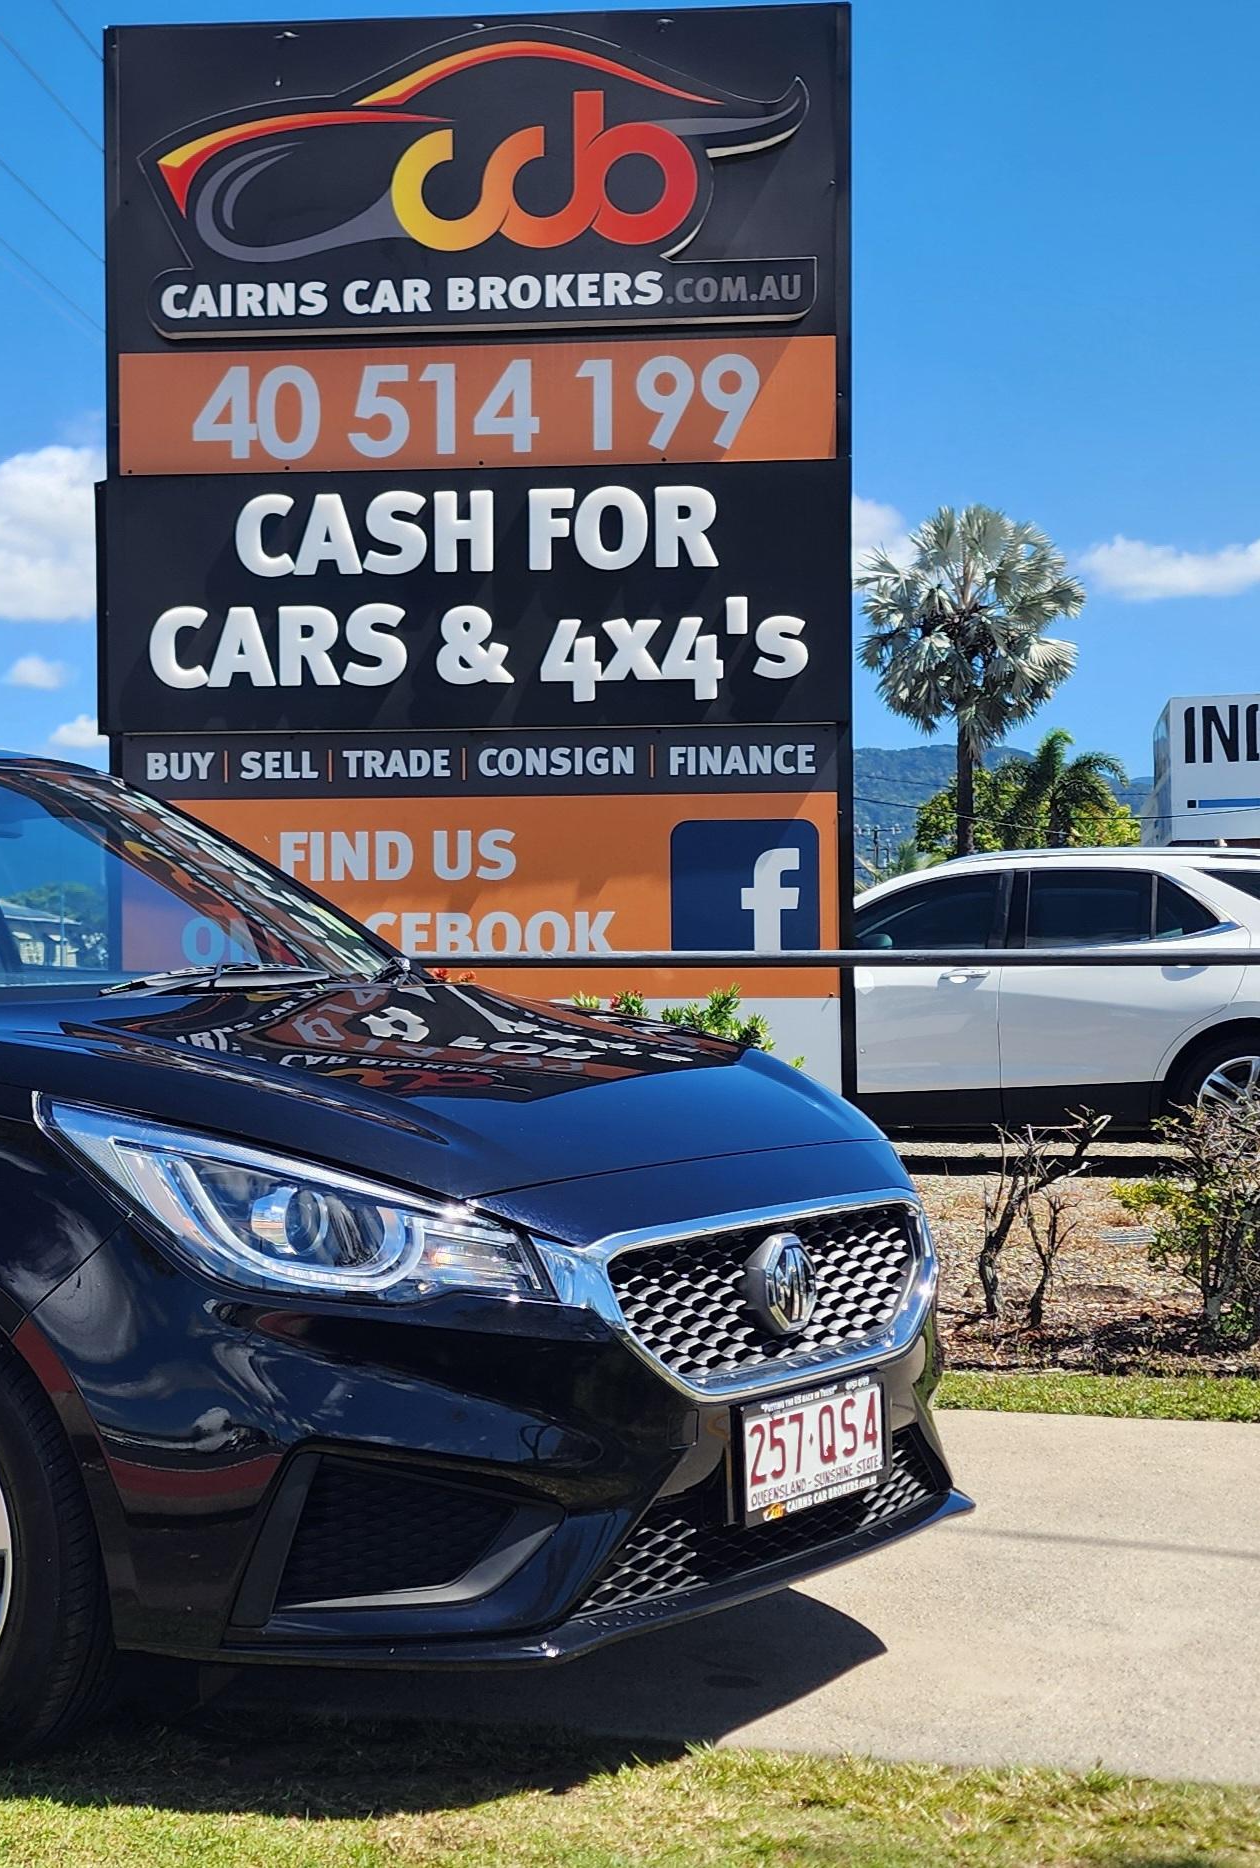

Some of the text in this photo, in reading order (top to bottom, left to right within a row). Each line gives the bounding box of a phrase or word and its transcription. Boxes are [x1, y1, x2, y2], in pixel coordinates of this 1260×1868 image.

[161, 281, 328, 319] CAIRNS
[343, 278, 432, 315] CAR
[192, 353, 760, 461] 40 514 199
[235, 485, 720, 578] CASH FOR
[149, 602, 408, 689] CARS
[436, 605, 515, 685] &
[147, 744, 816, 781] BUY SELL TRADE CONSIGN FINANCE
[279, 830, 414, 882] FIND
[433, 828, 517, 881] US
[367, 910, 617, 953] CEBOOK
[751, 1477, 806, 1507] QUEENSLAND
[814, 1462, 853, 1488] SUNSHINE
[856, 1454, 879, 1474] STATE
